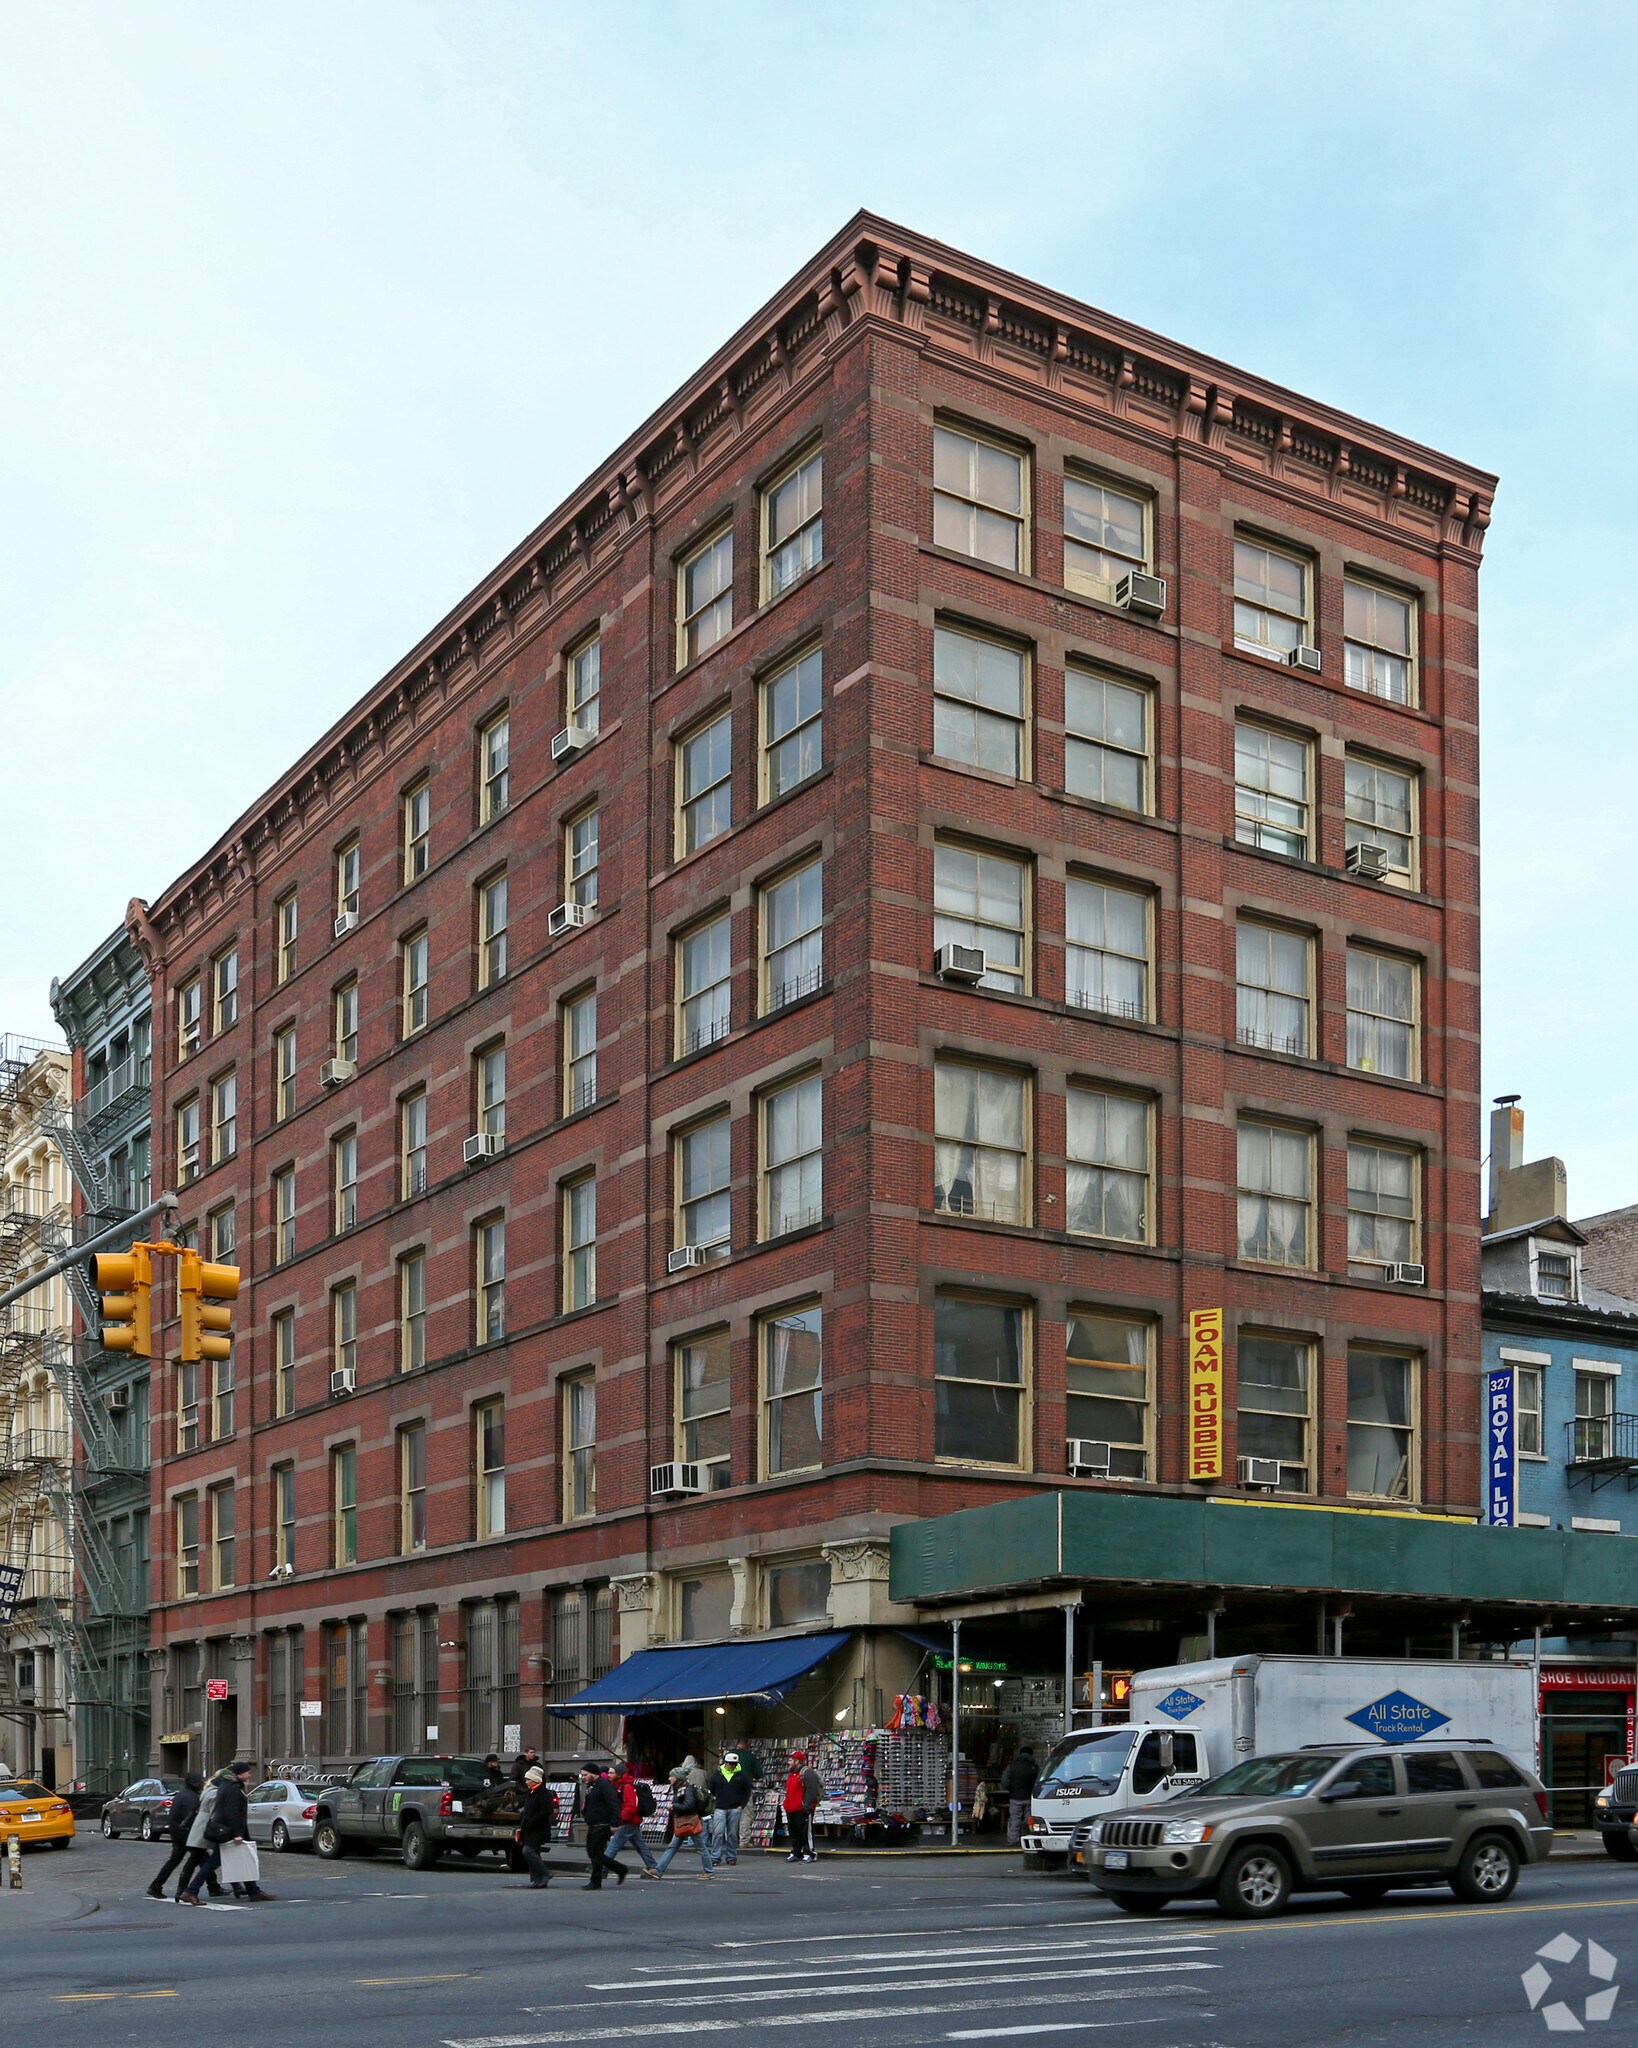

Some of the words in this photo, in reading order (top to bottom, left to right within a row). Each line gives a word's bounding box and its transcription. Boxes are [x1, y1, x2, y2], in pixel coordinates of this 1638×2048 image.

[1194, 1312, 1219, 1374] FOAM
[1490, 1377, 1511, 1392] 327
[1194, 1383, 1218, 1475] RUBBER
[1492, 1393, 1509, 1479] ROYAL
[1540, 1672, 1572, 1684] SHOE
[1165, 1697, 1174, 1707] All
[1175, 1695, 1195, 1705] State
[1368, 1704, 1387, 1720] All
[1391, 1704, 1431, 1720] State
[1373, 1721, 1396, 1733] Truck
[1397, 1722, 1425, 1733] Rental
[1056, 1787, 1082, 1796] ISUZU
